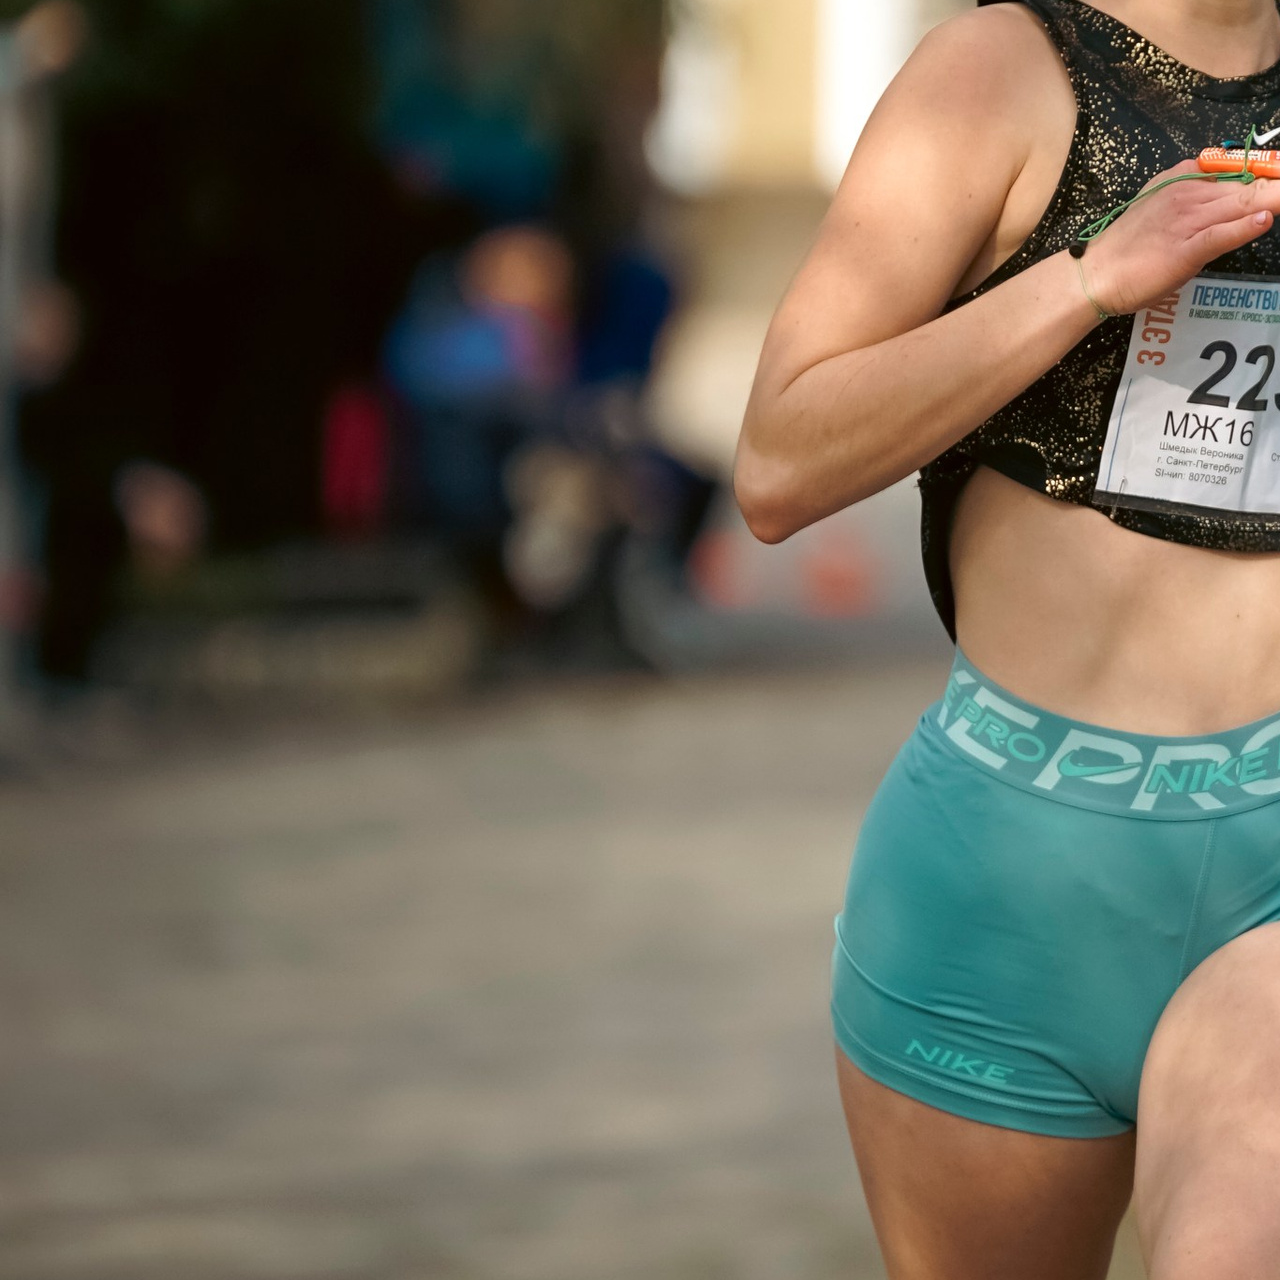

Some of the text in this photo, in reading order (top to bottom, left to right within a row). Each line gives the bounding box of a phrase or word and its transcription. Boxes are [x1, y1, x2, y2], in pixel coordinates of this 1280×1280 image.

[1188, 307, 1195, 318] 8
[1194, 308, 1220, 319] НОЯБРЯ
[1191, 284, 1279, 311] ПЕРВЕНСТВО
[1136, 290, 1180, 366] 3 ЭТА
[1163, 410, 1255, 447] МЖ16
[1166, 455, 1244, 476] Санкт-Петербург
[1199, 446, 1244, 461] Вероника
[1188, 471, 1228, 486] 8070326
[954, 696, 1046, 762] PRO
[1145, 747, 1270, 793] NIKE
[905, 1038, 1016, 1084] NIKE
